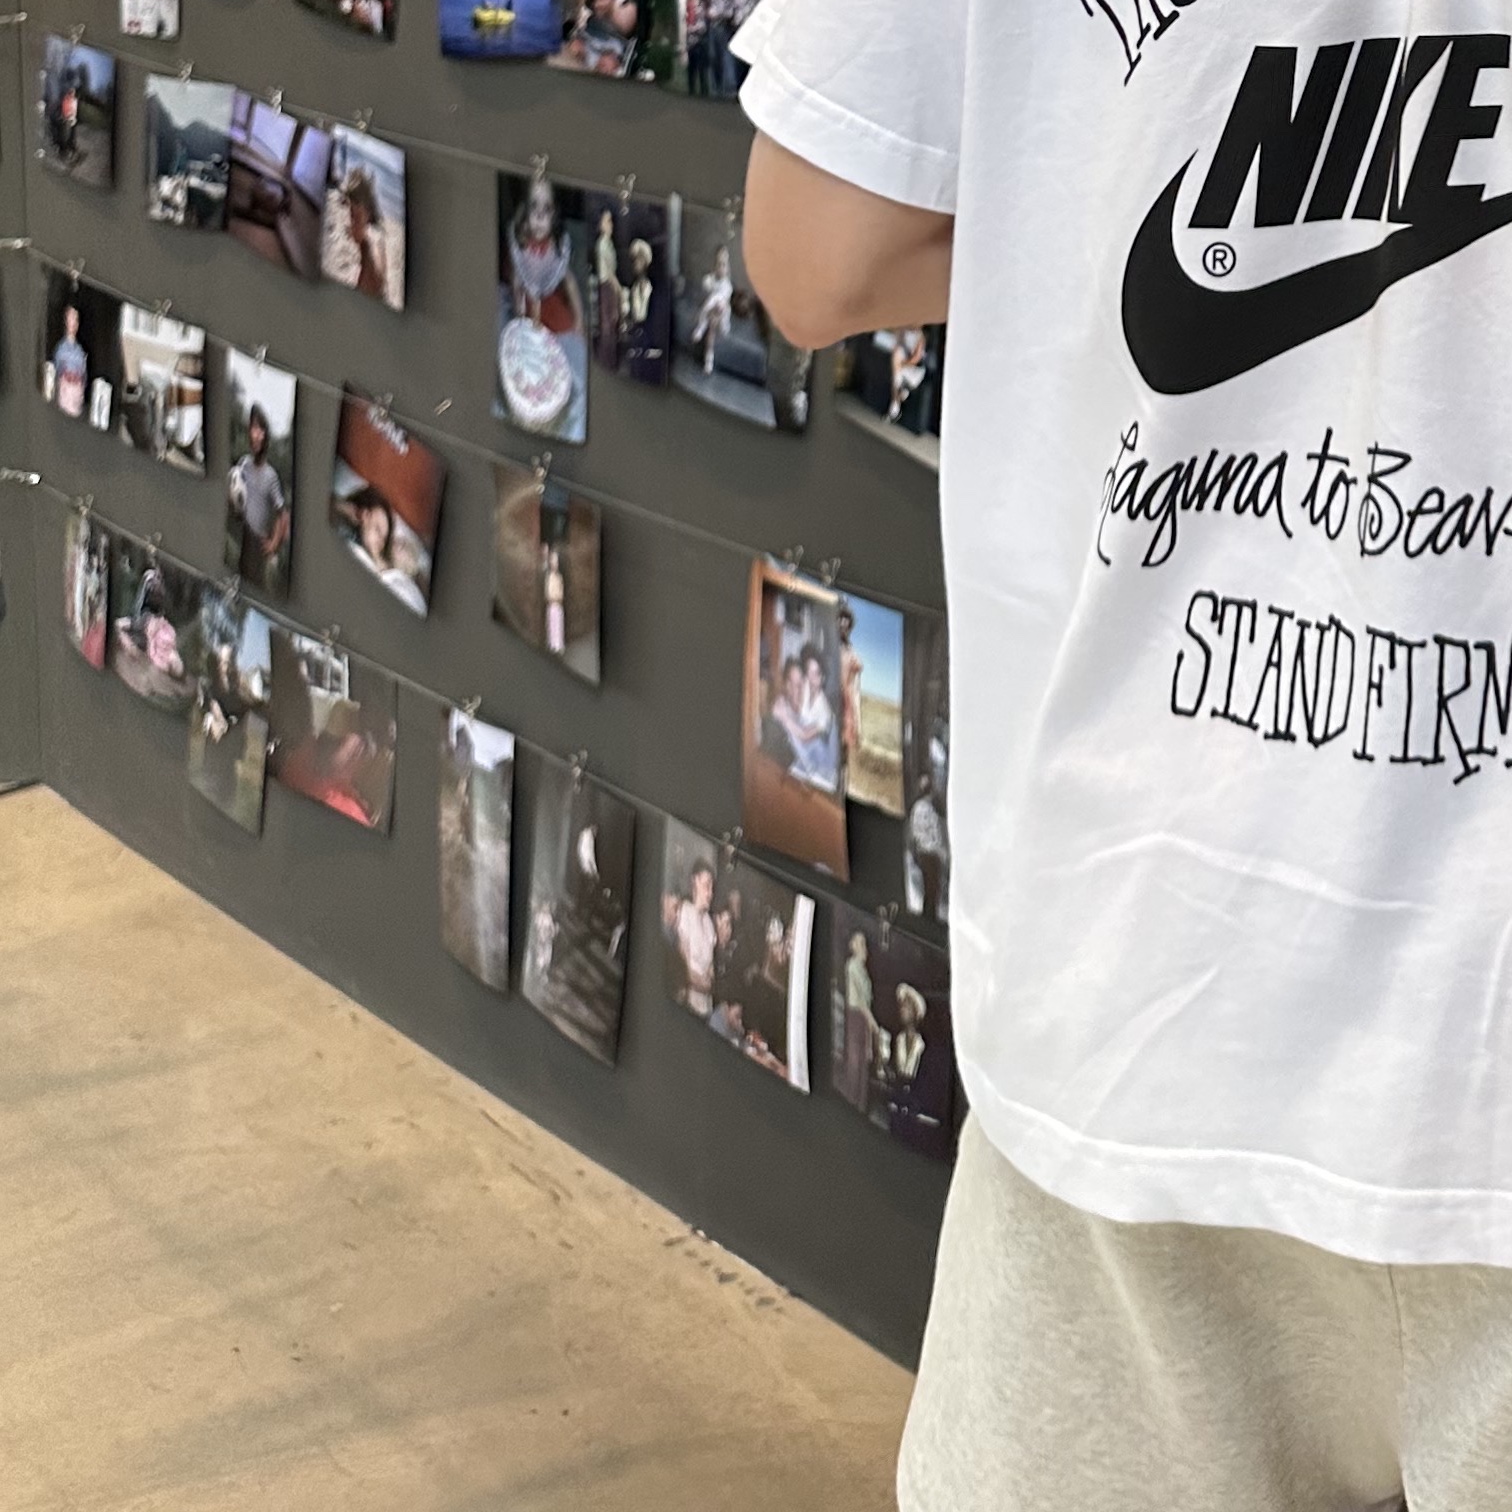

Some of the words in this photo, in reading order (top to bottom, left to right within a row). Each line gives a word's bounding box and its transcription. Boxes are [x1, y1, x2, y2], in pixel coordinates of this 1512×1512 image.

[1188, 34, 1512, 229] NIKE
[1301, 427, 1357, 540] to
[1171, 591, 1355, 748] STAND
